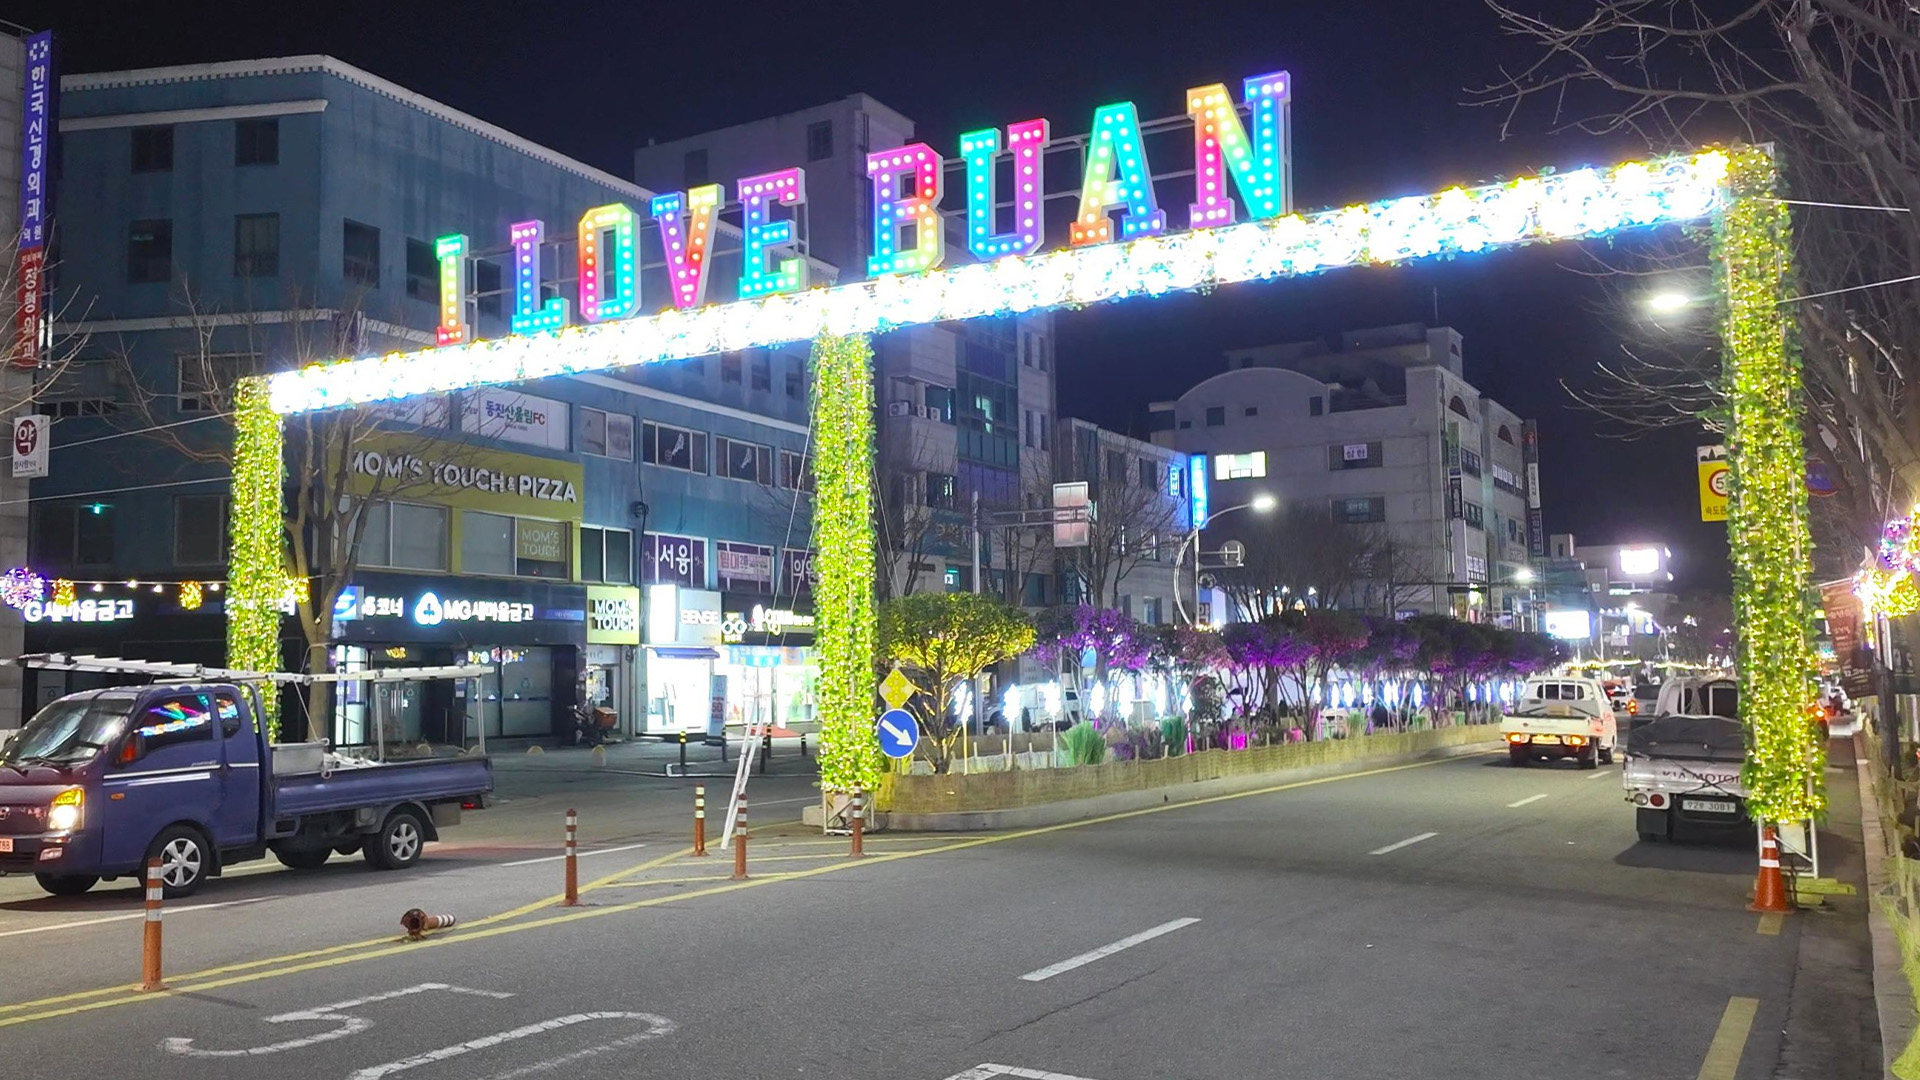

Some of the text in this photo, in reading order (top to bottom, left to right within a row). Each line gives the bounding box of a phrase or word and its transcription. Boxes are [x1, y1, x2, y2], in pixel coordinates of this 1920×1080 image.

[27, 64, 46, 221] 한국신경외과
[434, 70, 1291, 345] I LOVE BUAN
[23, 267, 37, 358] 정형외과
[486, 400, 546, 425] 동진산울림FC
[18, 424, 36, 453] 약
[353, 450, 577, 503] MOM'S TOUCH & PIZZA
[521, 528, 560, 544] MOM'S
[523, 543, 560, 557] TOUCH
[24, 599, 134, 622] G새마을금고
[443, 598, 534, 622] MG새마을금고
[594, 599, 634, 615] MOM'S
[594, 617, 634, 632] TOUCH
[1693, 773, 1741, 784] MOTO
